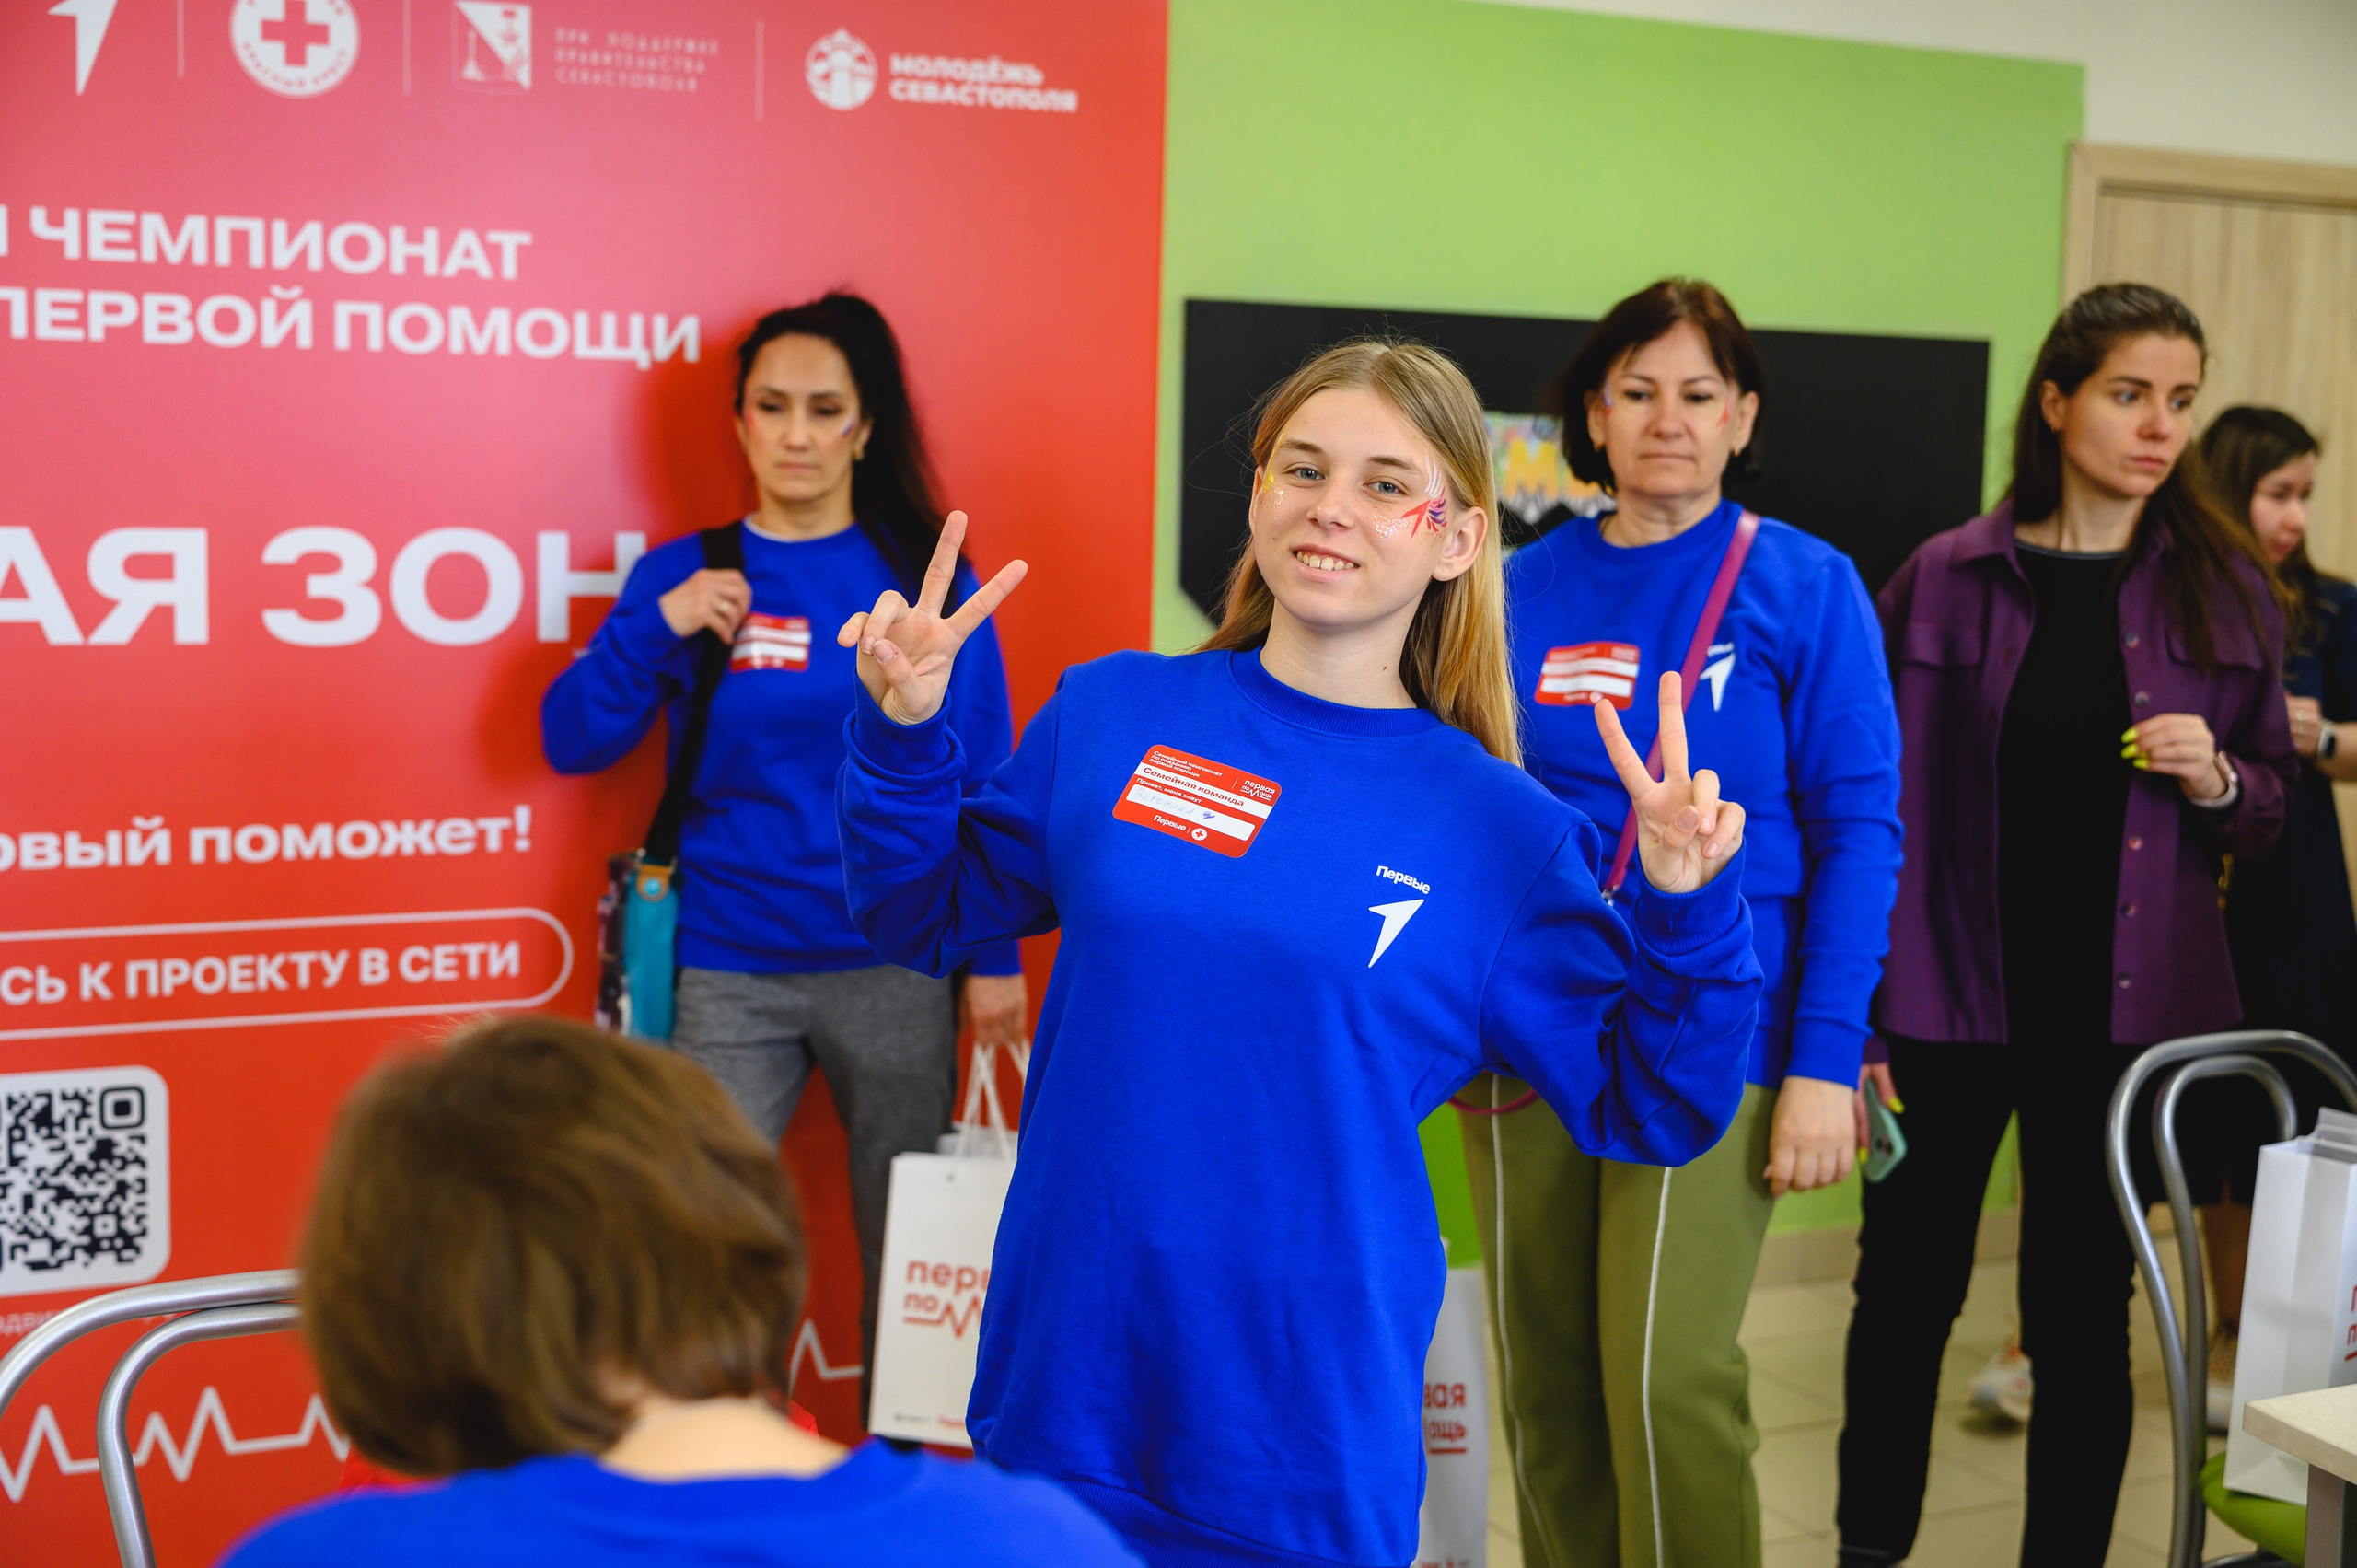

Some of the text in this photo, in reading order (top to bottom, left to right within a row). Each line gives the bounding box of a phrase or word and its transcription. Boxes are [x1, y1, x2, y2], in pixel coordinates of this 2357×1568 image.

[889, 78, 1078, 112] СЕВАСТОПОЛЯ
[29, 206, 532, 280] ЧЕМПИОНАТ
[333, 299, 700, 369] ПОМОЩИ
[1149, 758, 1201, 778] первой помощи
[1154, 750, 1223, 777] Семейный чемпионат
[1136, 777, 1202, 804] Привет, меня зовут
[1143, 767, 1245, 807] Семейная команда
[1244, 780, 1276, 795] первая
[190, 805, 531, 864] поможет!
[1153, 814, 1187, 831] Первые
[1376, 865, 1431, 895] Первые
[80, 961, 112, 1001] К
[125, 949, 350, 999] ПРОЕКТУ
[359, 947, 390, 986] В
[399, 940, 520, 982] СЕТИ
